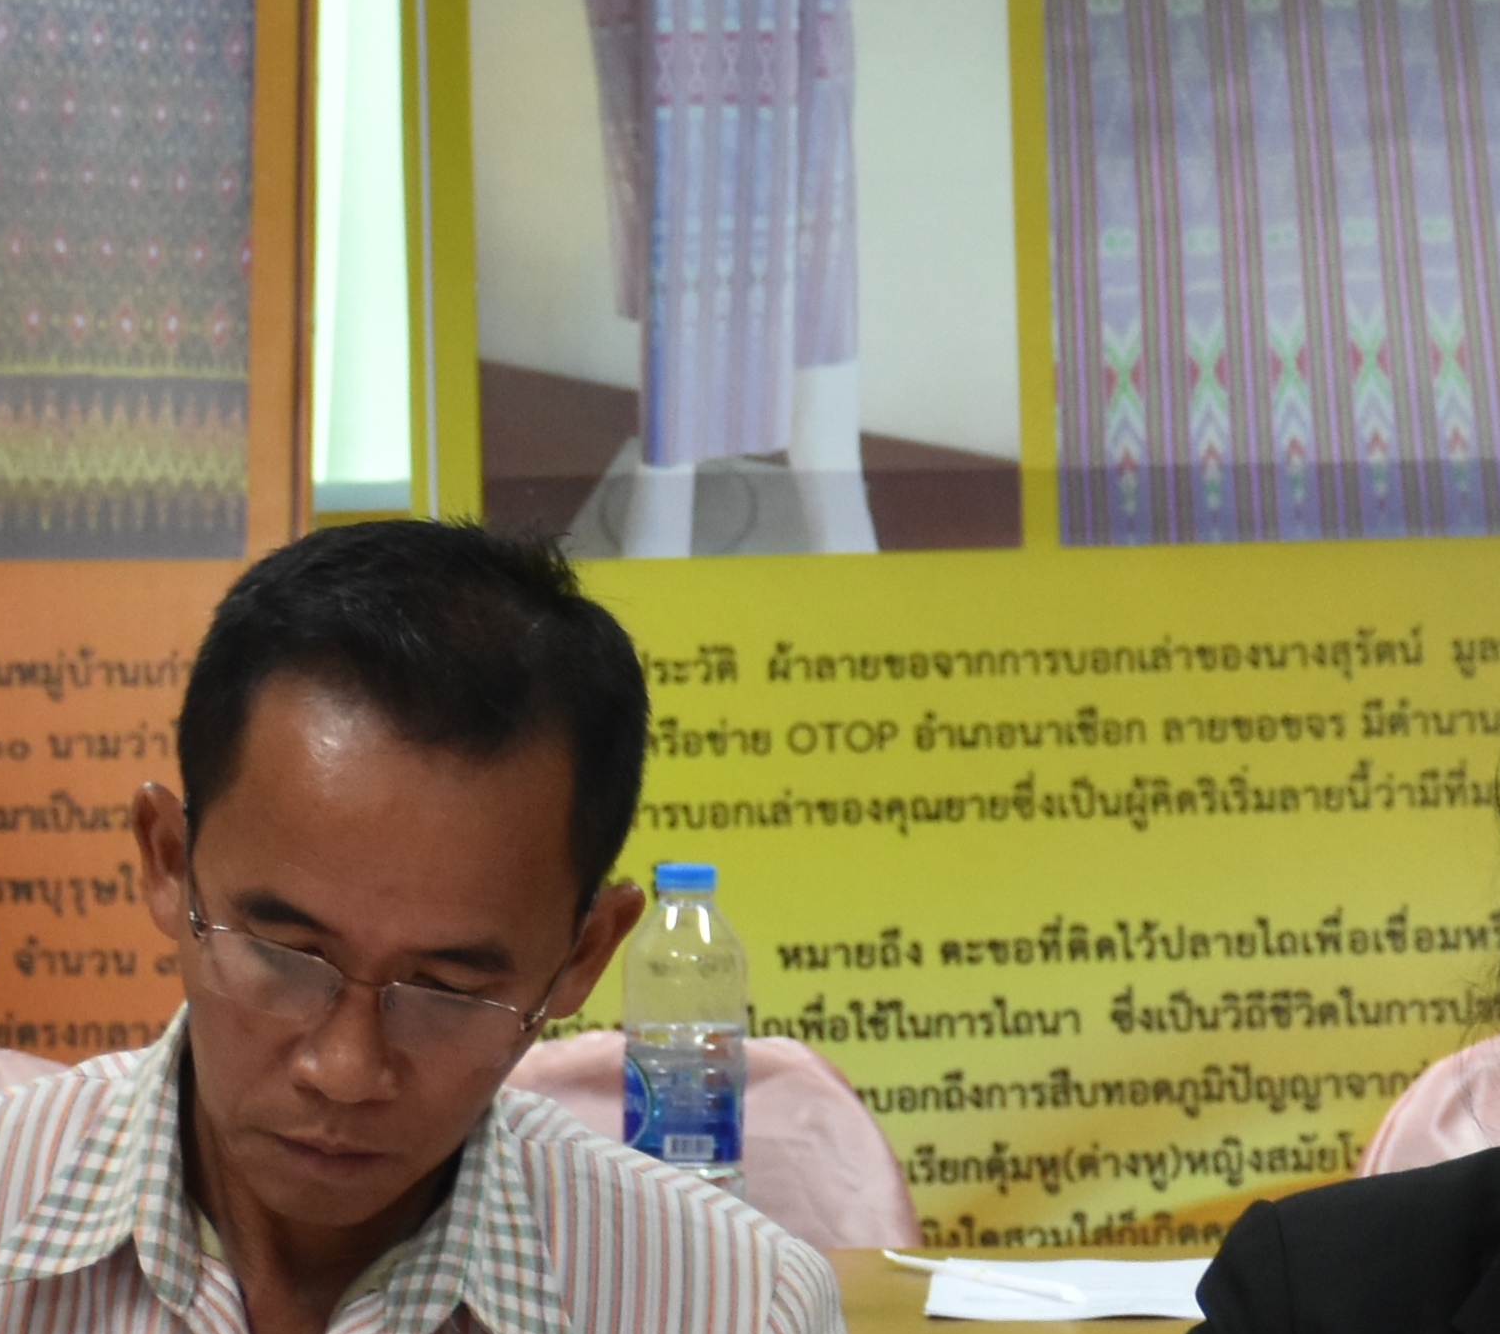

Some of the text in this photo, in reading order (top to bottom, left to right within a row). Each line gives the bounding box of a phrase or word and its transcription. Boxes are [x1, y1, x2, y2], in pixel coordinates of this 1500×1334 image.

[786, 719, 900, 755] OTOP
[915, 704, 1148, 753] อำเภอนาเชือก
[1162, 710, 1347, 746] ลายขอขจร
[777, 925, 925, 972] หมายถึง
